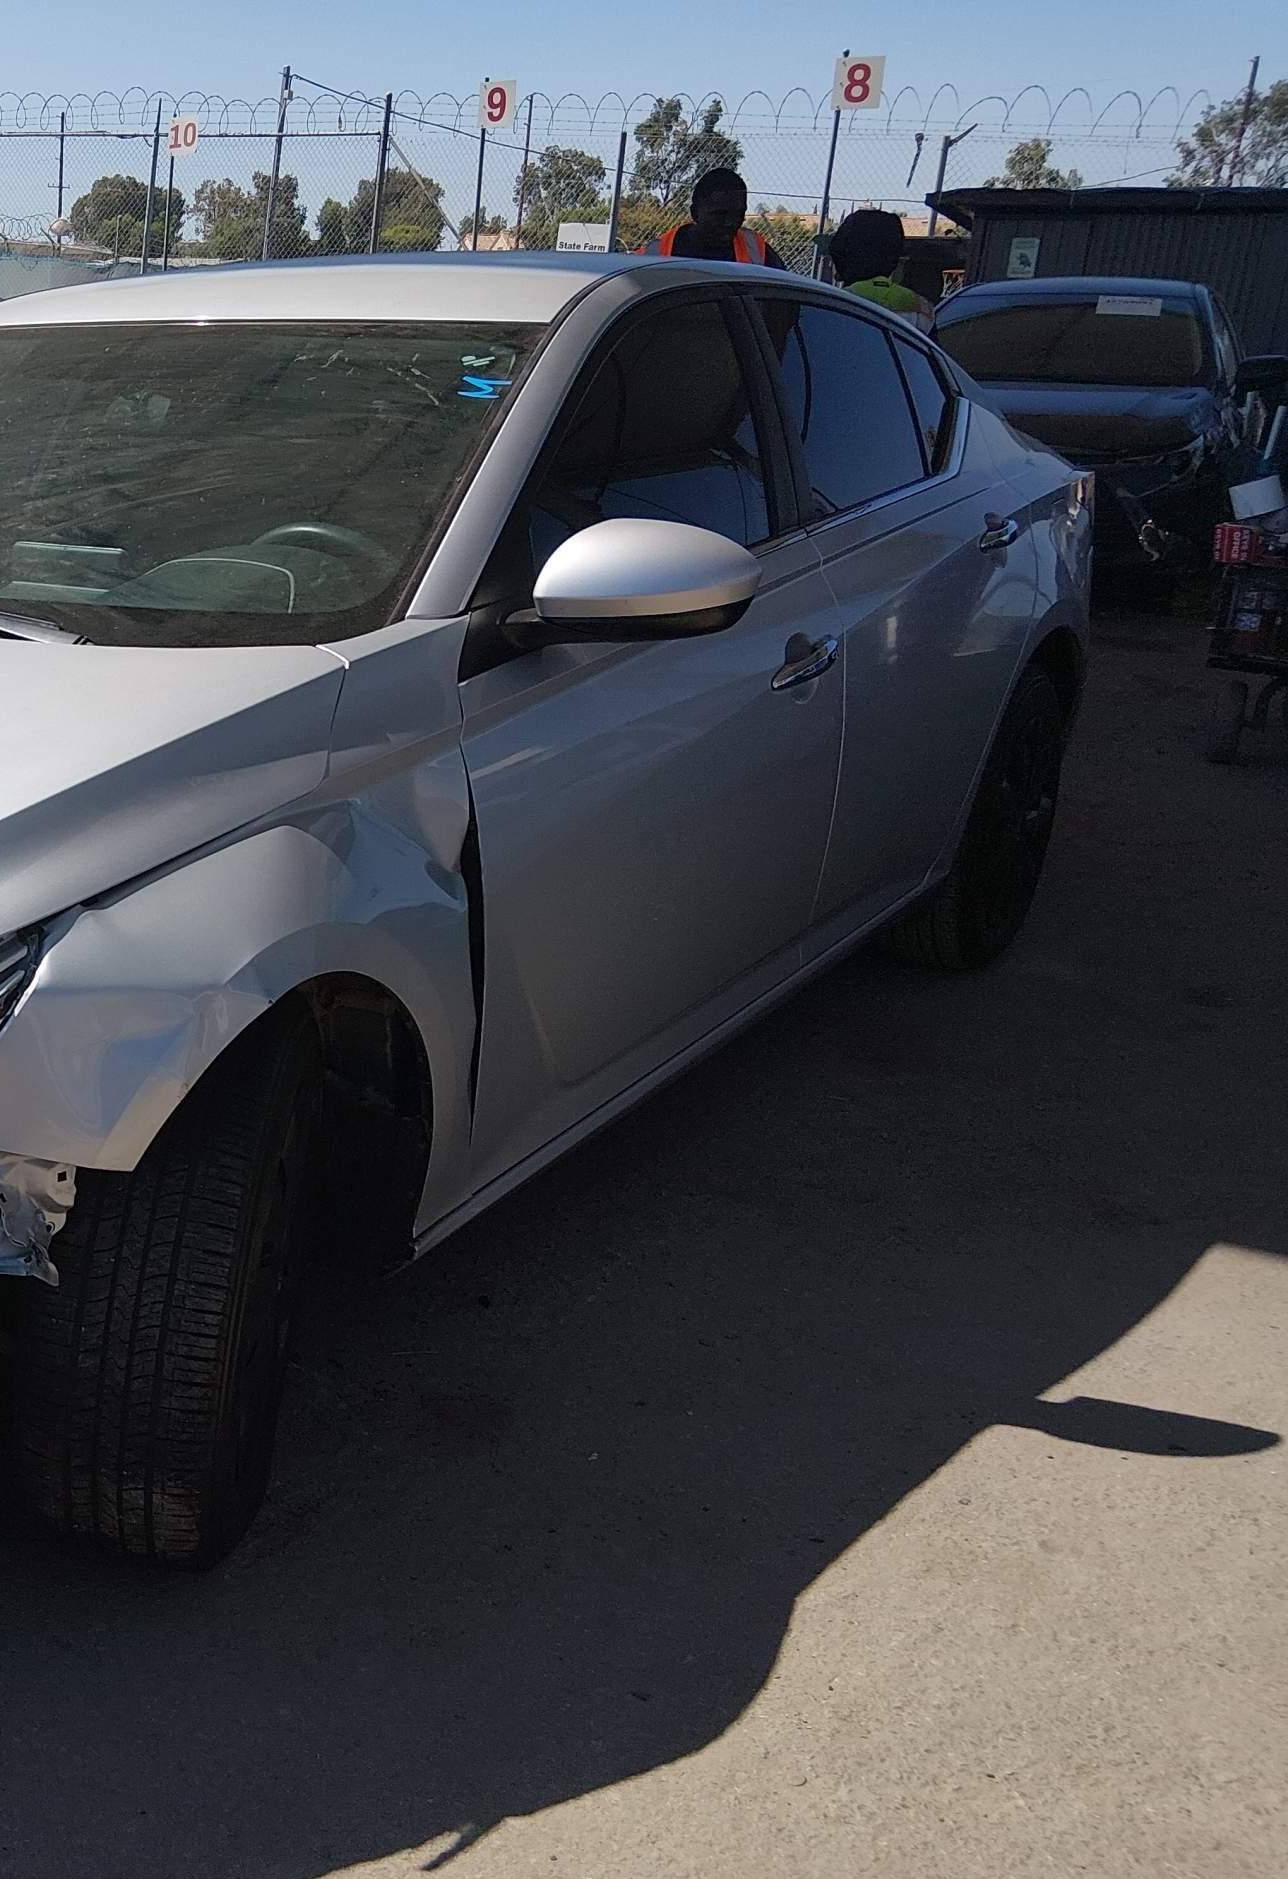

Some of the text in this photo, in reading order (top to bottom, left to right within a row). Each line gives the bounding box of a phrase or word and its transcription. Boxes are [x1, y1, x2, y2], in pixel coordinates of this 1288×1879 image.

[844, 63, 871, 103] 8
[487, 87, 506, 122] 9
[169, 122, 197, 149] 10
[558, 241, 606, 252] State Farm
